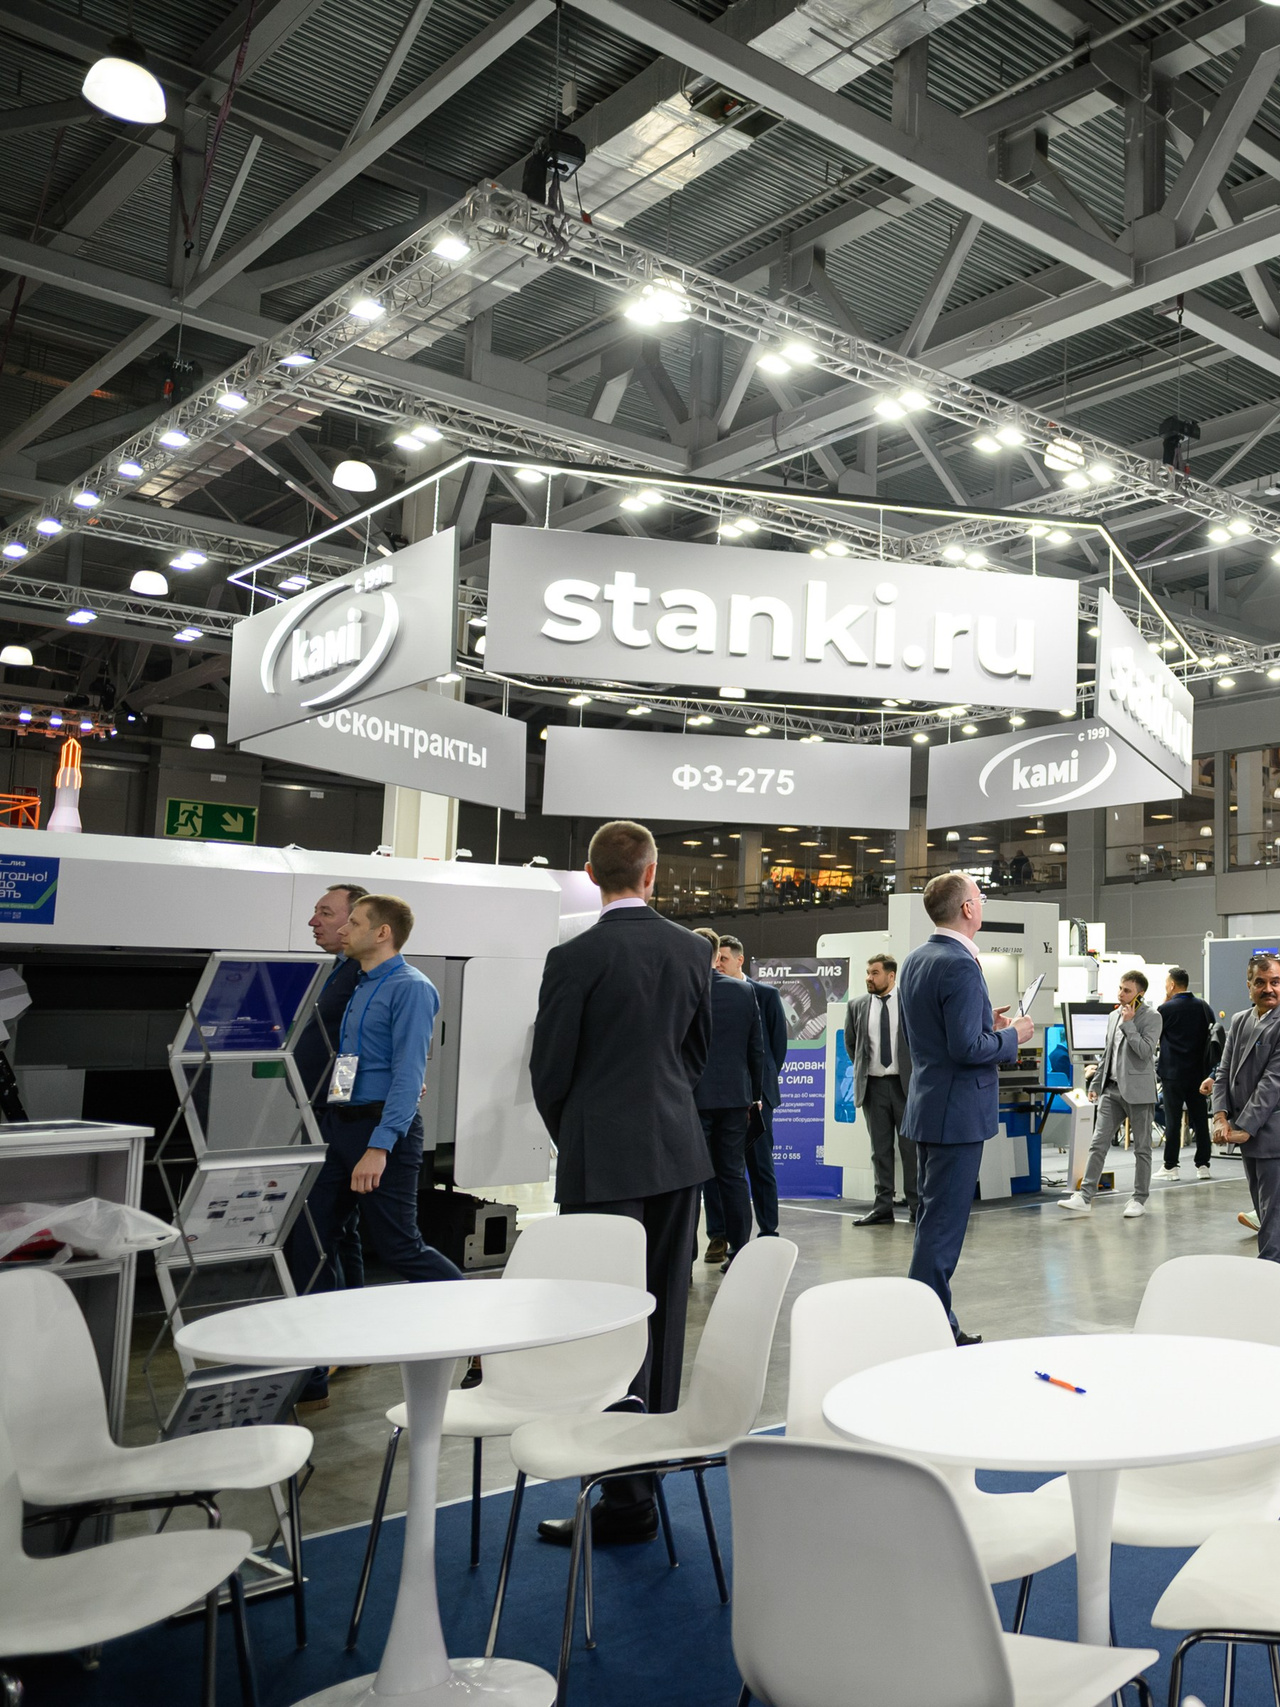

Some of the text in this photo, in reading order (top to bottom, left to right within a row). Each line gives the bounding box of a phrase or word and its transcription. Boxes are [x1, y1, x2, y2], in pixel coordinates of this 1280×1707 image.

[540, 570, 1036, 679] stanki.ru
[304, 708, 487, 769] осконтракты
[1087, 726, 1110, 741] 1991
[0, 871, 48, 882] годно!
[0, 880, 16, 889] до
[0, 889, 22, 899] ать
[786, 1075, 814, 1085] сила
